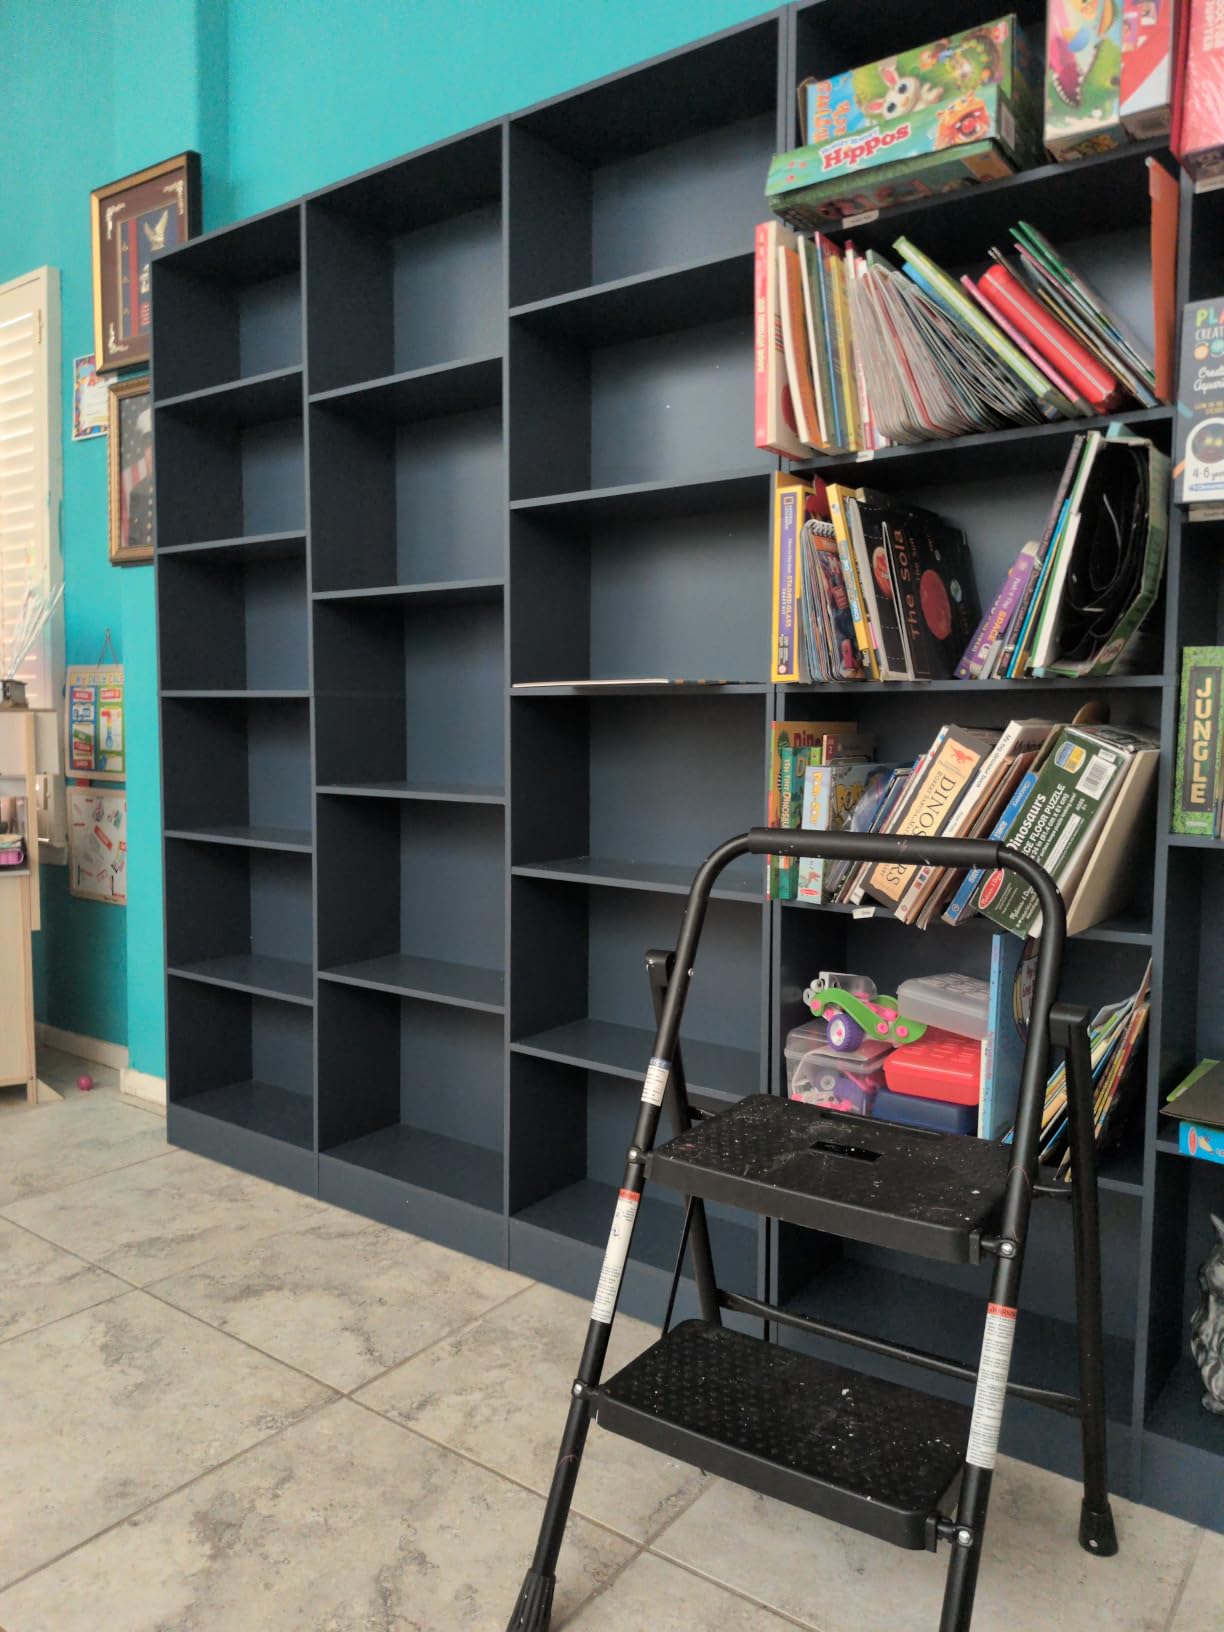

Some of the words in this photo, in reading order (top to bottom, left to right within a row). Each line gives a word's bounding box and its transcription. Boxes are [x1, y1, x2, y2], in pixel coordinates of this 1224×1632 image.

[822, 123, 910, 170] Hippos
[906, 594, 920, 640] The
[988, 610, 1007, 641] SPACE
[1190, 677, 1213, 804] JUNGLE
[781, 791, 791, 828] DINOSAU
[887, 776, 956, 886] DINOSRS
[1030, 814, 1049, 842] FLOOR
[1044, 783, 1066, 815] PUZZLE
